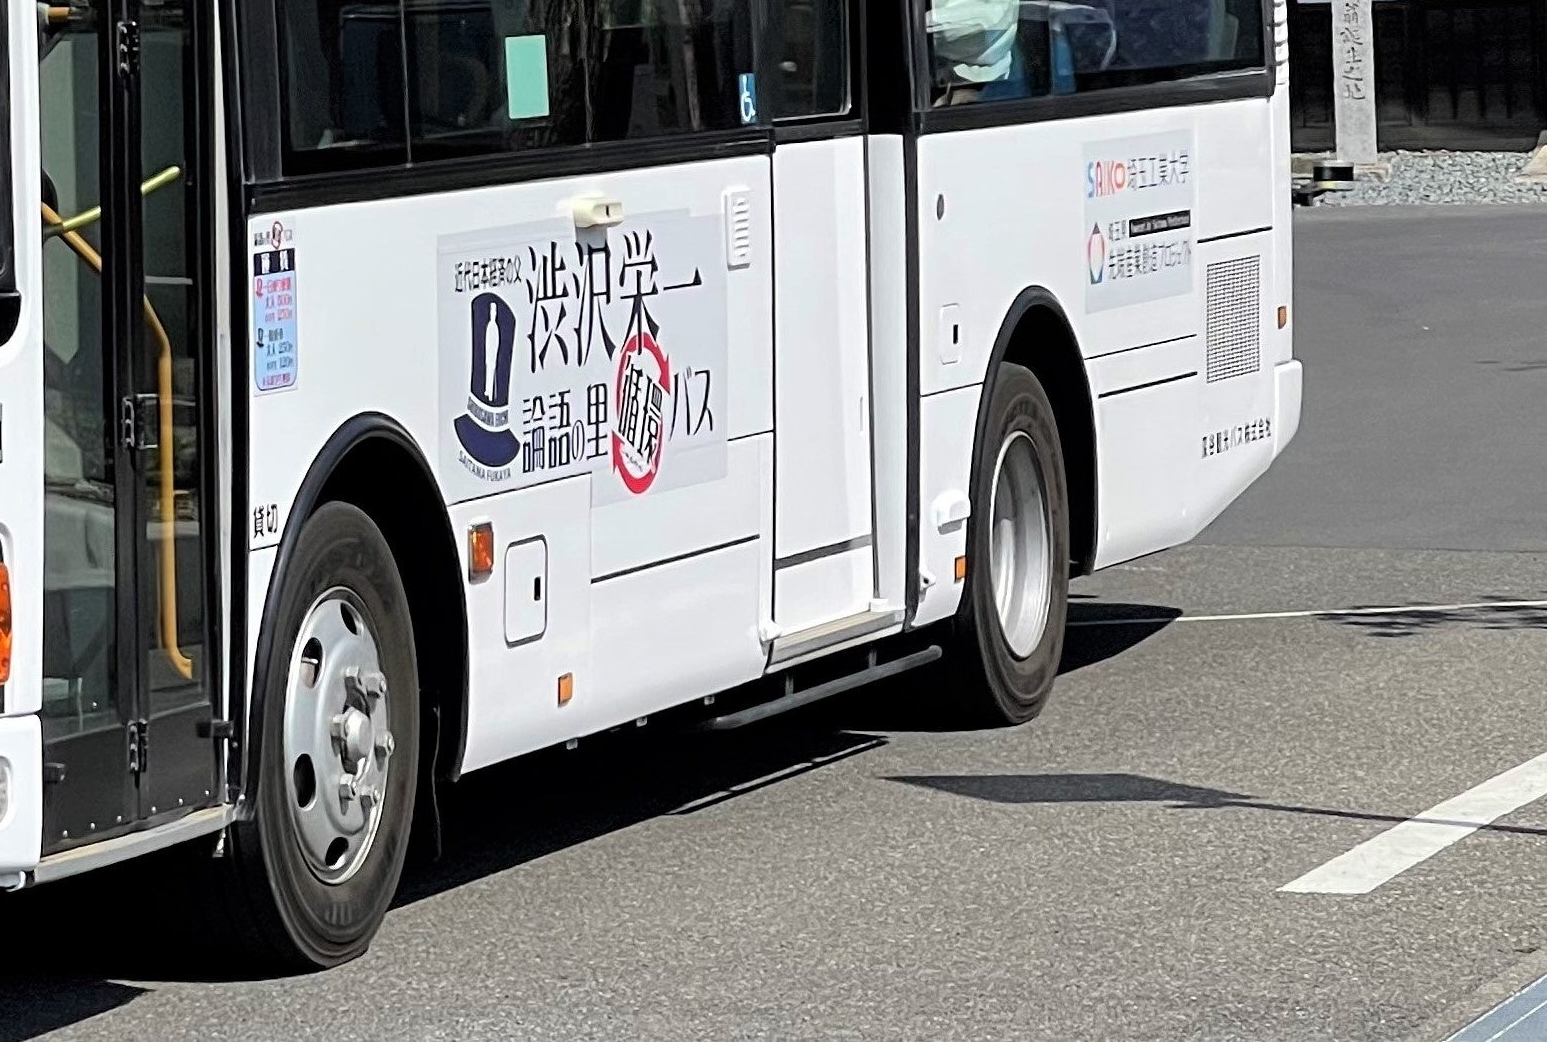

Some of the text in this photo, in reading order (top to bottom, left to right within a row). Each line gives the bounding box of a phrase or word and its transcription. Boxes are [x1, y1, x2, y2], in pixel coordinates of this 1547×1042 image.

[1087, 161, 1127, 198] SAIKO
[454, 254, 522, 293] 近代日本経済の父
[525, 229, 703, 373] 渋沢栄一
[253, 503, 278, 539] 貸切
